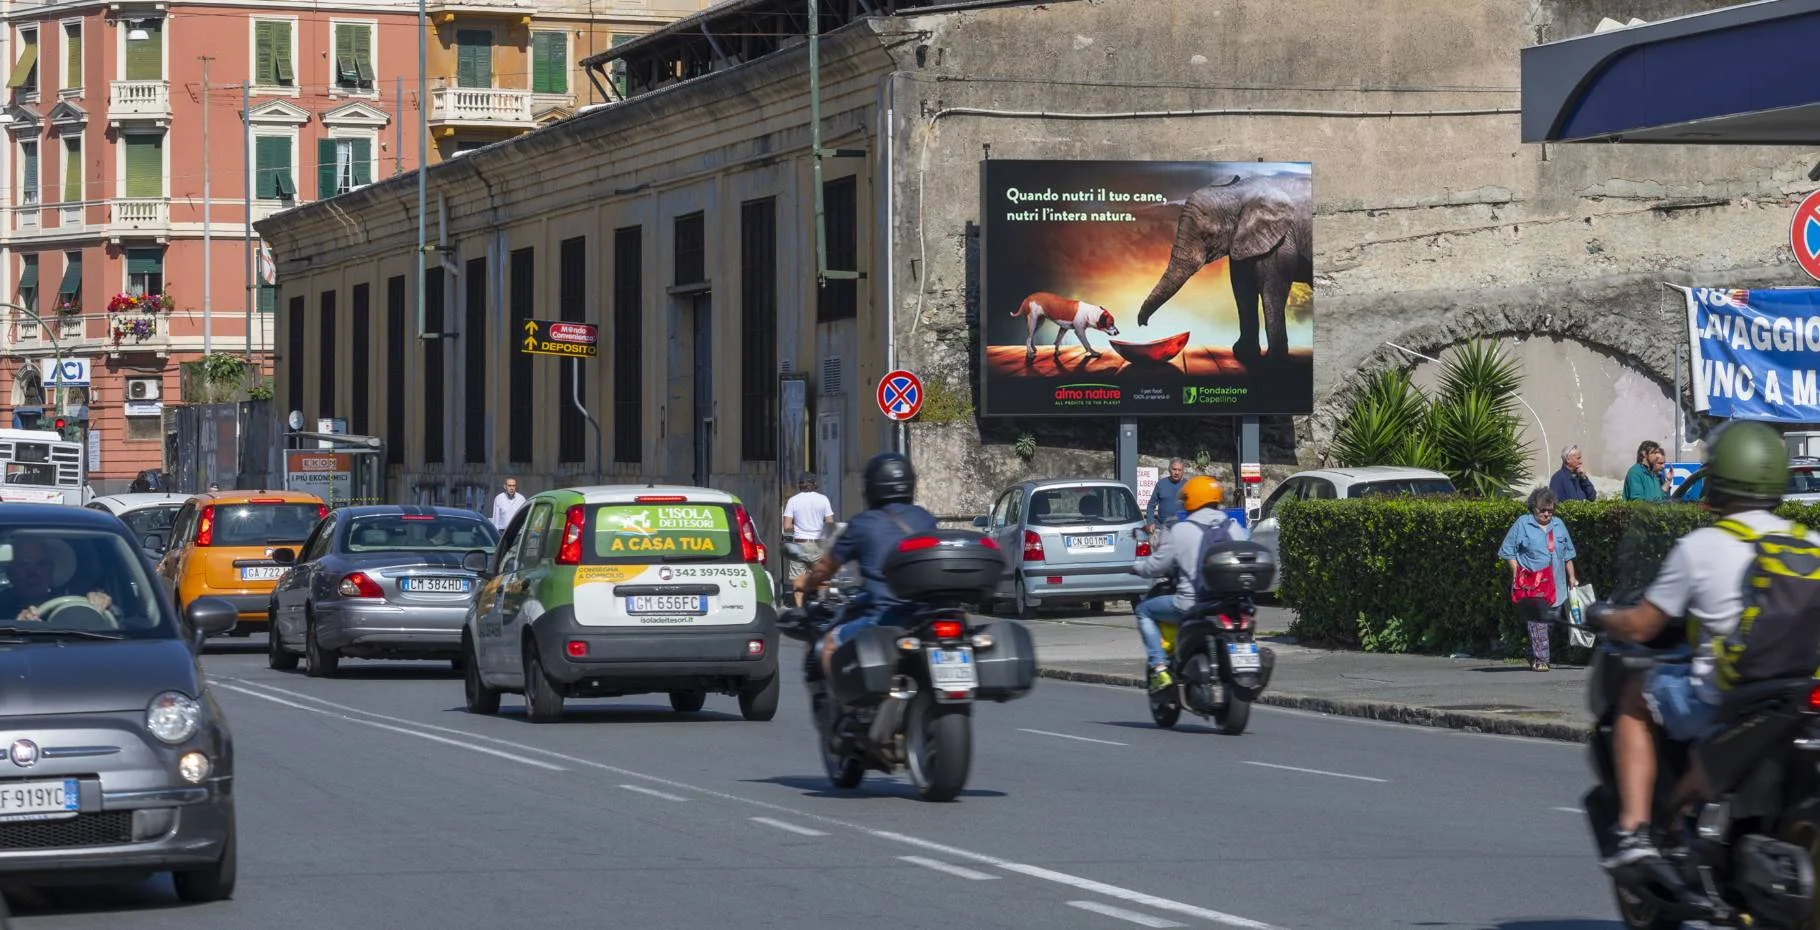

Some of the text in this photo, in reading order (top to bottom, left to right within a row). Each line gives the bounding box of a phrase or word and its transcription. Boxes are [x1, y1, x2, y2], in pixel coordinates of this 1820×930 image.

[1006, 188, 1168, 204] Quando nutri il tuo cane,
[1006, 208, 1039, 221] nutri
[1090, 211, 1136, 222] natura.
[541, 341, 596, 354] DEPOSITO
[50, 360, 84, 380] ACI
[1055, 388, 1120, 399] almo nature
[1199, 387, 1248, 395] Fondazione
[1764, 370, 1784, 406] A
[1199, 396, 1238, 404] Capellino
[658, 508, 712, 519] L'ISOLA
[659, 519, 714, 528] DEI TESORI
[611, 538, 714, 551] A CASA TUA
[248, 567, 260, 578] GA
[674, 568, 747, 577] 342 3974592
[410, 578, 424, 590] CM
[428, 578, 461, 591] 384HD
[636, 596, 653, 610] GM
[657, 596, 699, 610] 656FC
[640, 616, 694, 625] isoladeitesori.it
[15, 788, 64, 808] 919YC
